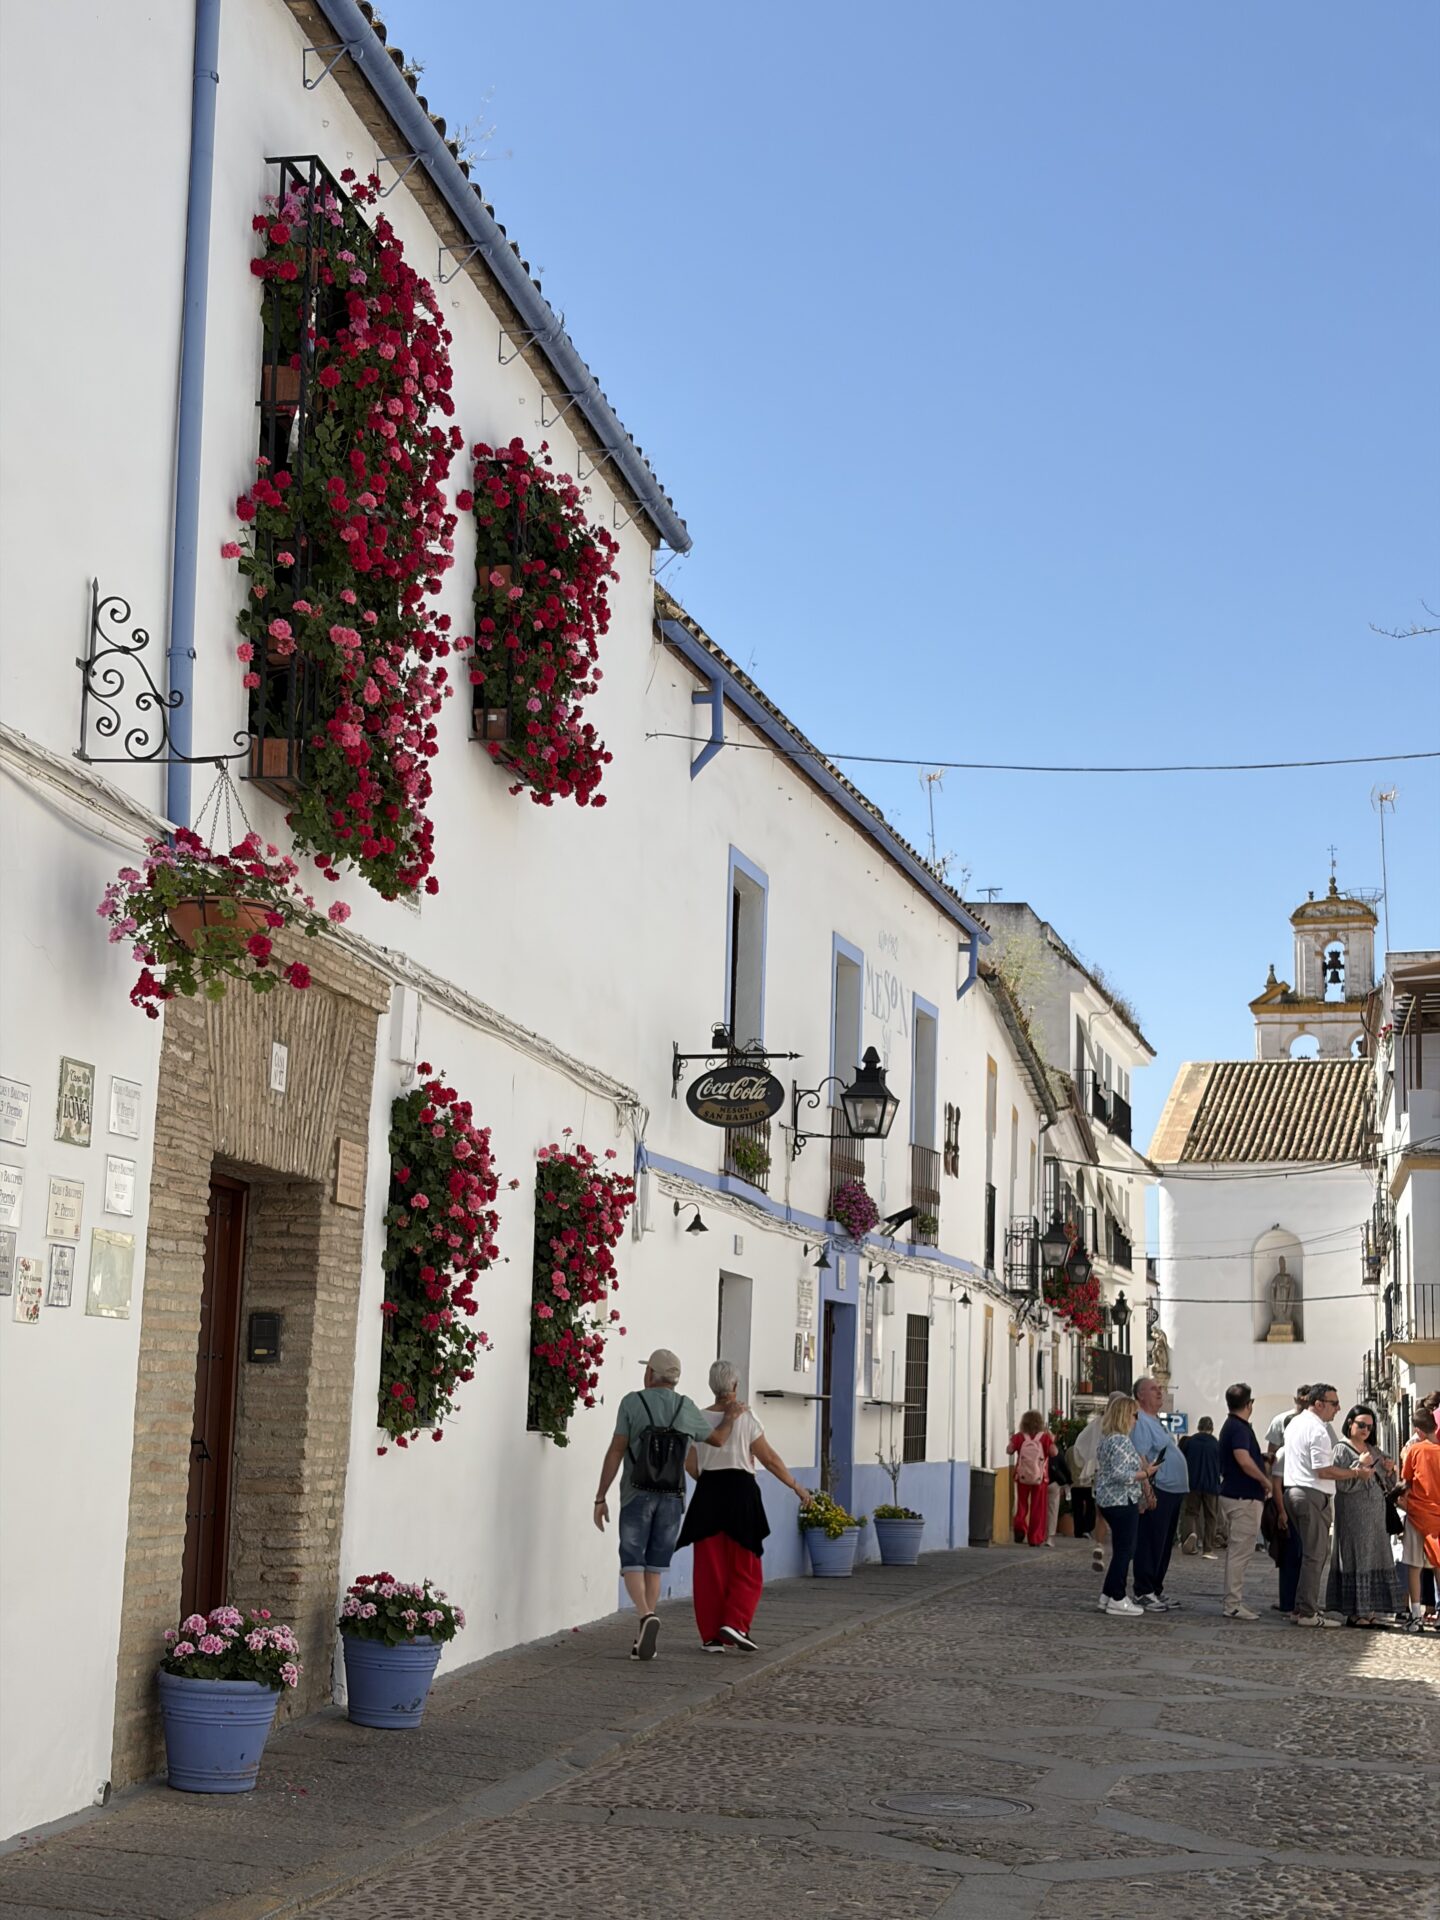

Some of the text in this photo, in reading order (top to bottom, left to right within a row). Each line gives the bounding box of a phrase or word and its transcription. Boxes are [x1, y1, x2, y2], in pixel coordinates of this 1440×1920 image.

[696, 1076, 771, 1101] Coca-Cola
[704, 1110, 765, 1121] SAN BASILIO
[1170, 1415, 1184, 1432] P
